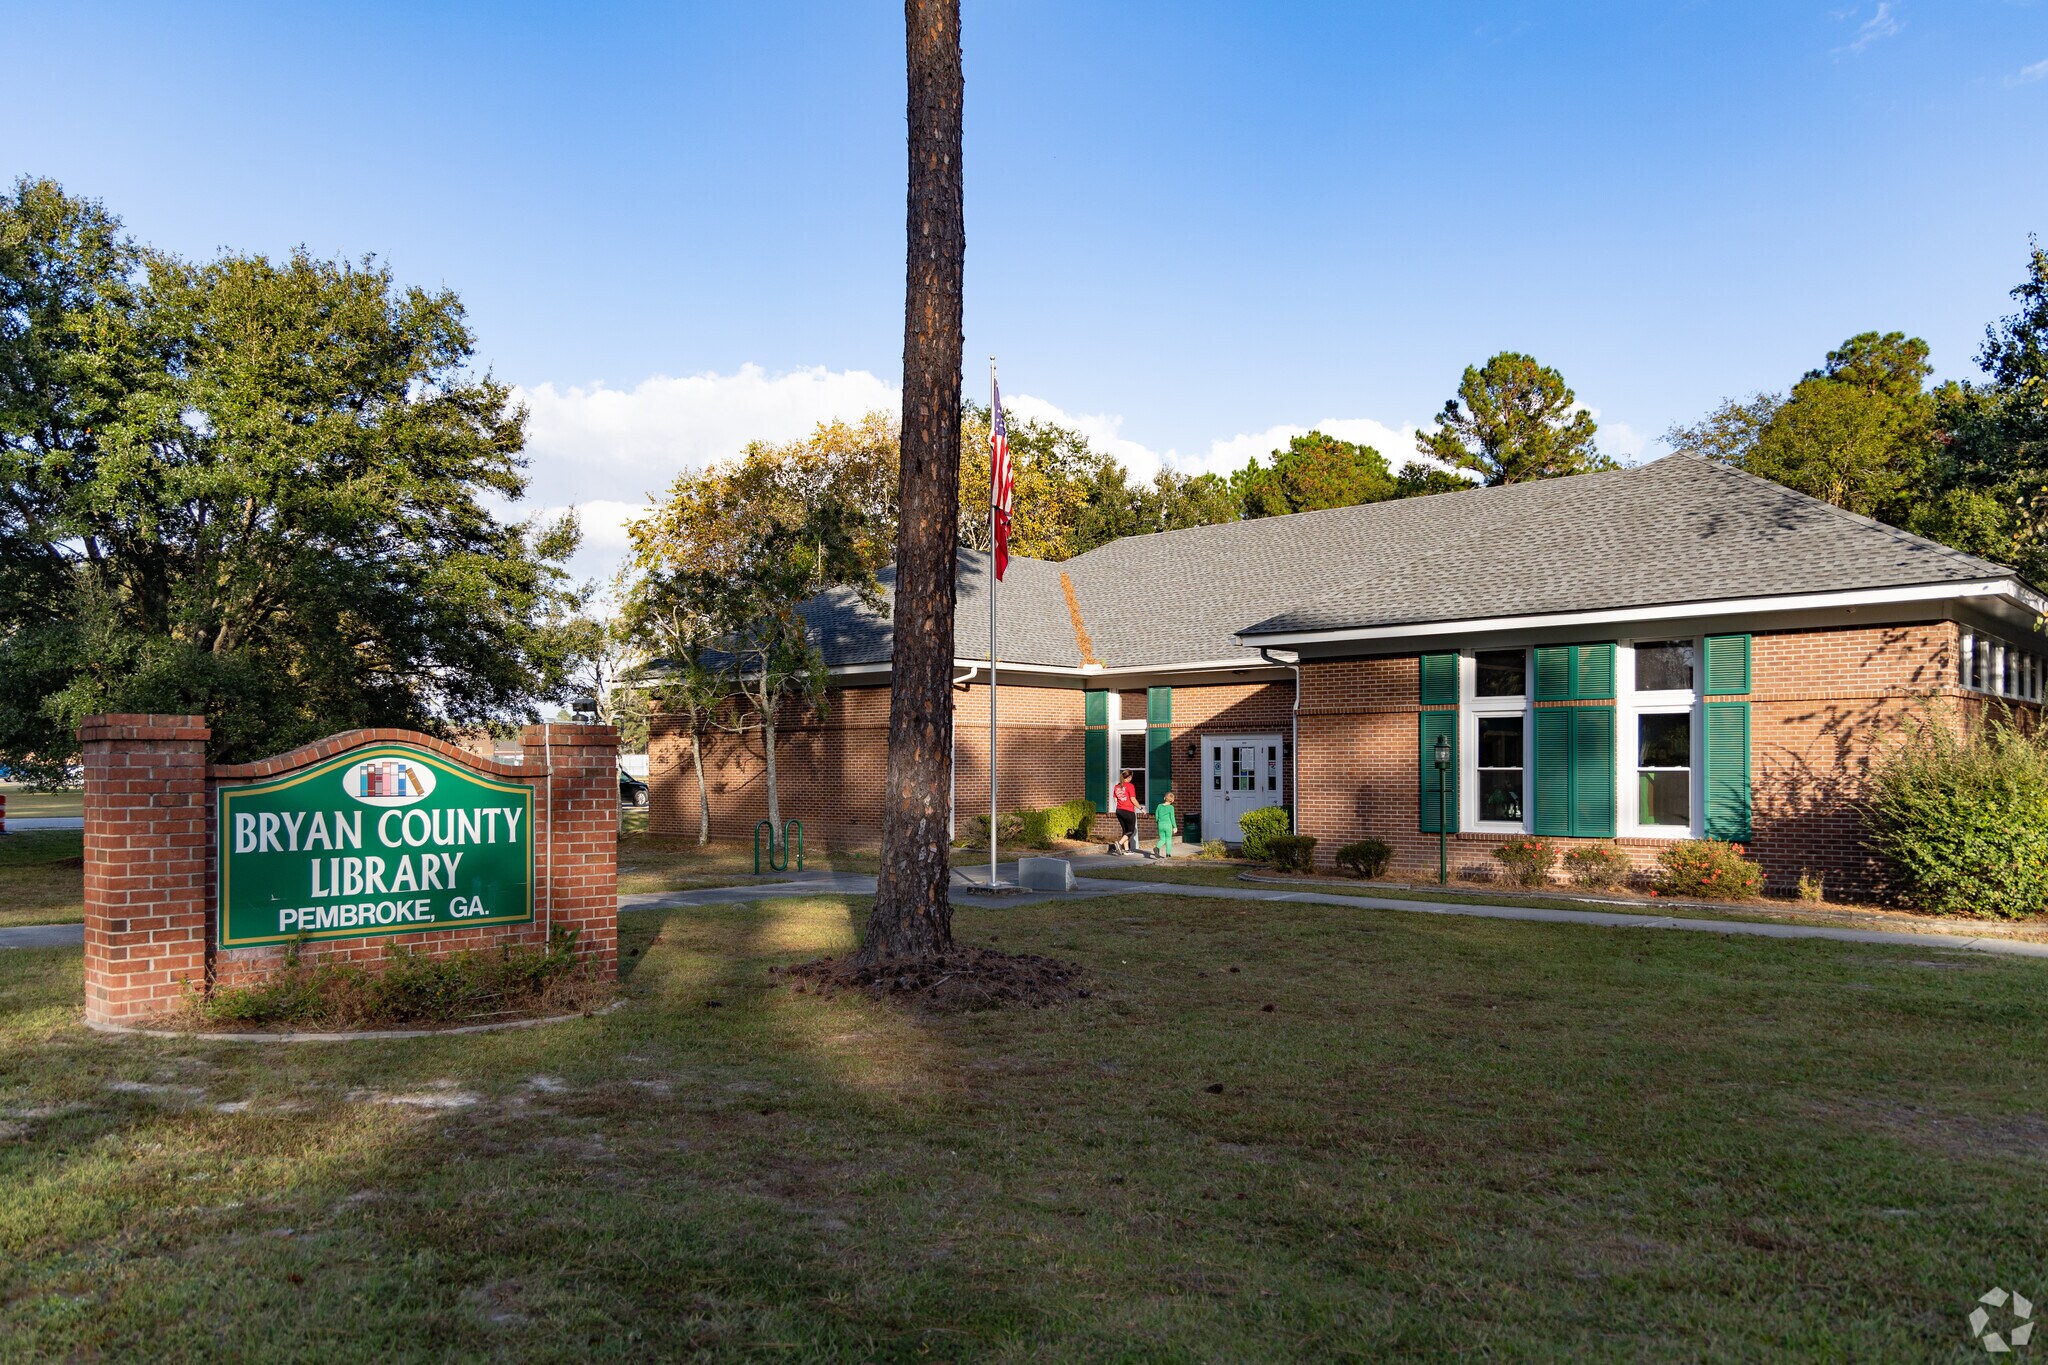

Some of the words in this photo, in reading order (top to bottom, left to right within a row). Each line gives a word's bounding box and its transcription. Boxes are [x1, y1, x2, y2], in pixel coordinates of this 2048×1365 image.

[235, 811, 363, 854] BRYAN
[377, 807, 523, 848] COUNTY
[311, 852, 464, 898] LIBRARY
[279, 898, 436, 932] PEMBROKE,
[449, 895, 490, 918] GA.
